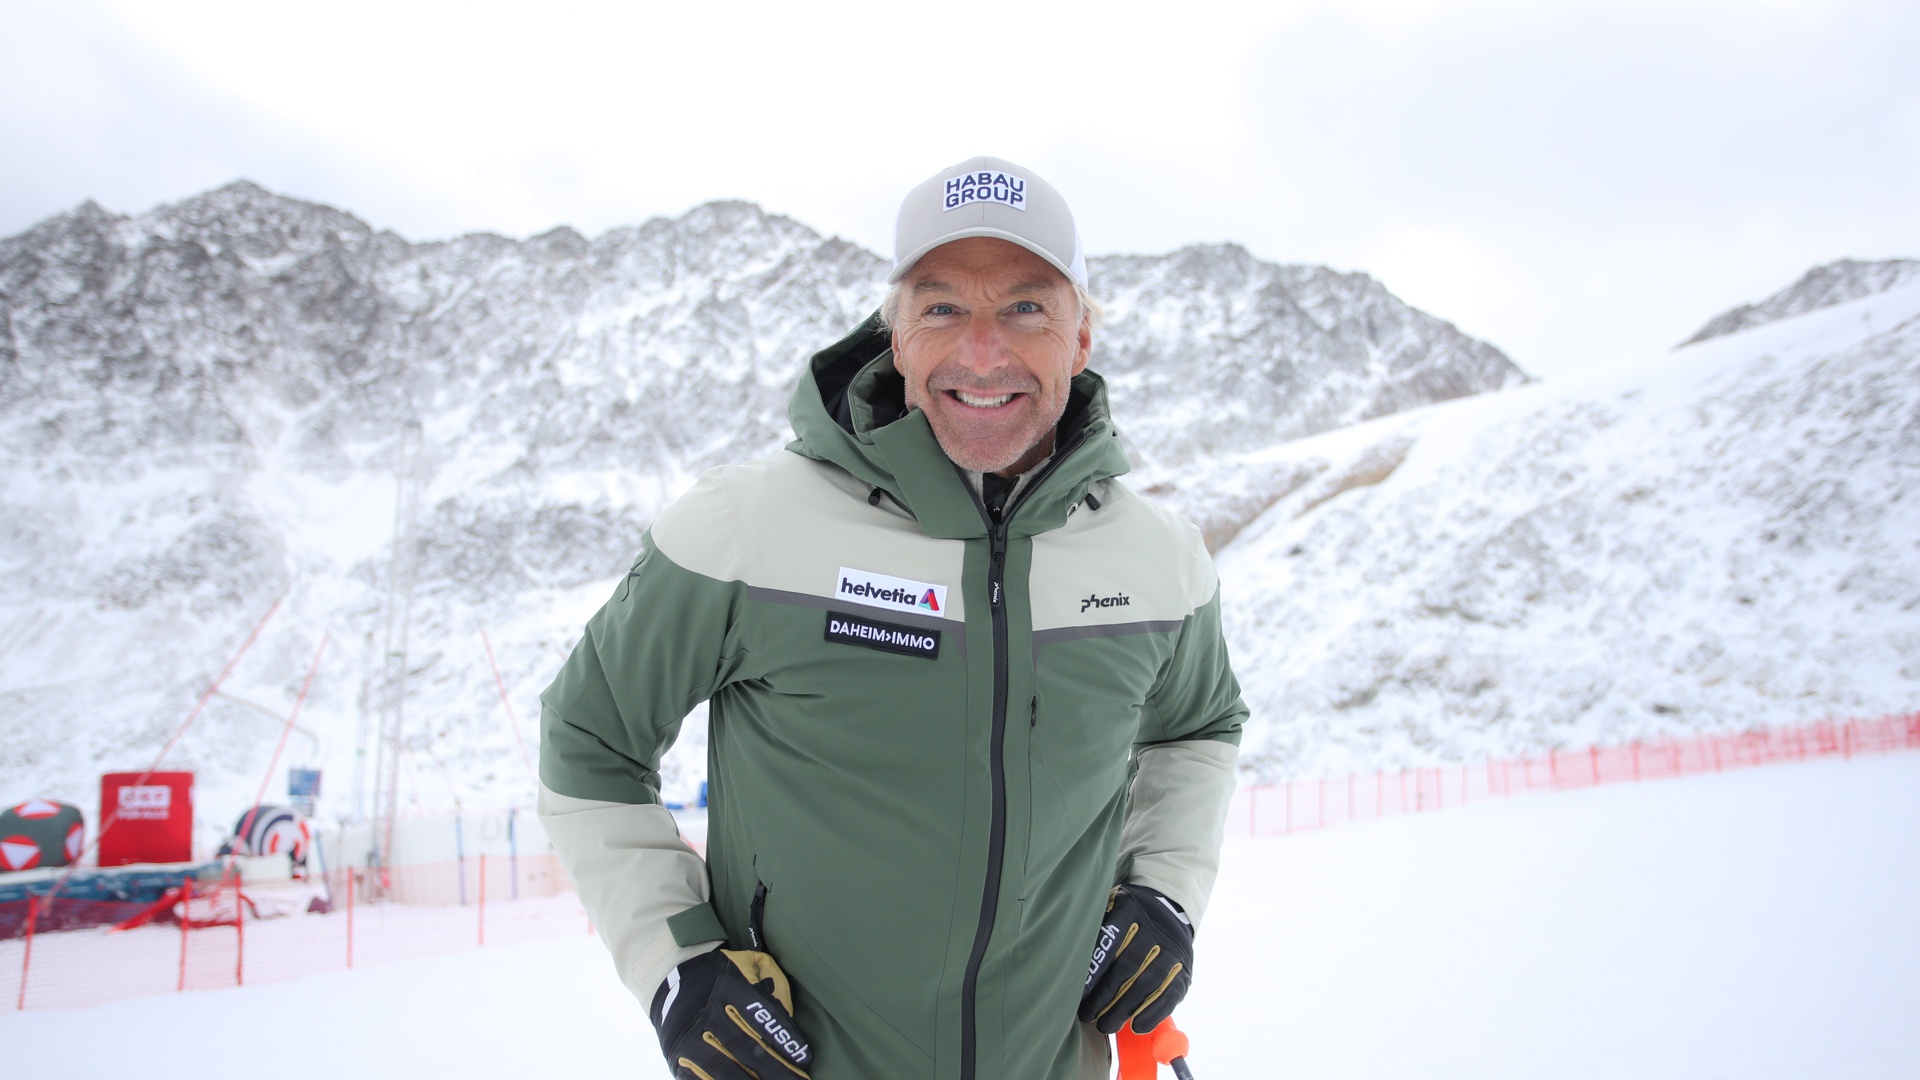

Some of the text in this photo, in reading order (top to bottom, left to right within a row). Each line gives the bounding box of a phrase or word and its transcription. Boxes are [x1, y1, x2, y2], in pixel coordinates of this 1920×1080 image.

[946, 172, 1024, 194] HABAU
[946, 186, 1023, 208] GROUP
[840, 577, 917, 606] helvetia
[1081, 592, 1130, 613] phenix
[746, 1001, 808, 1063] reusch
